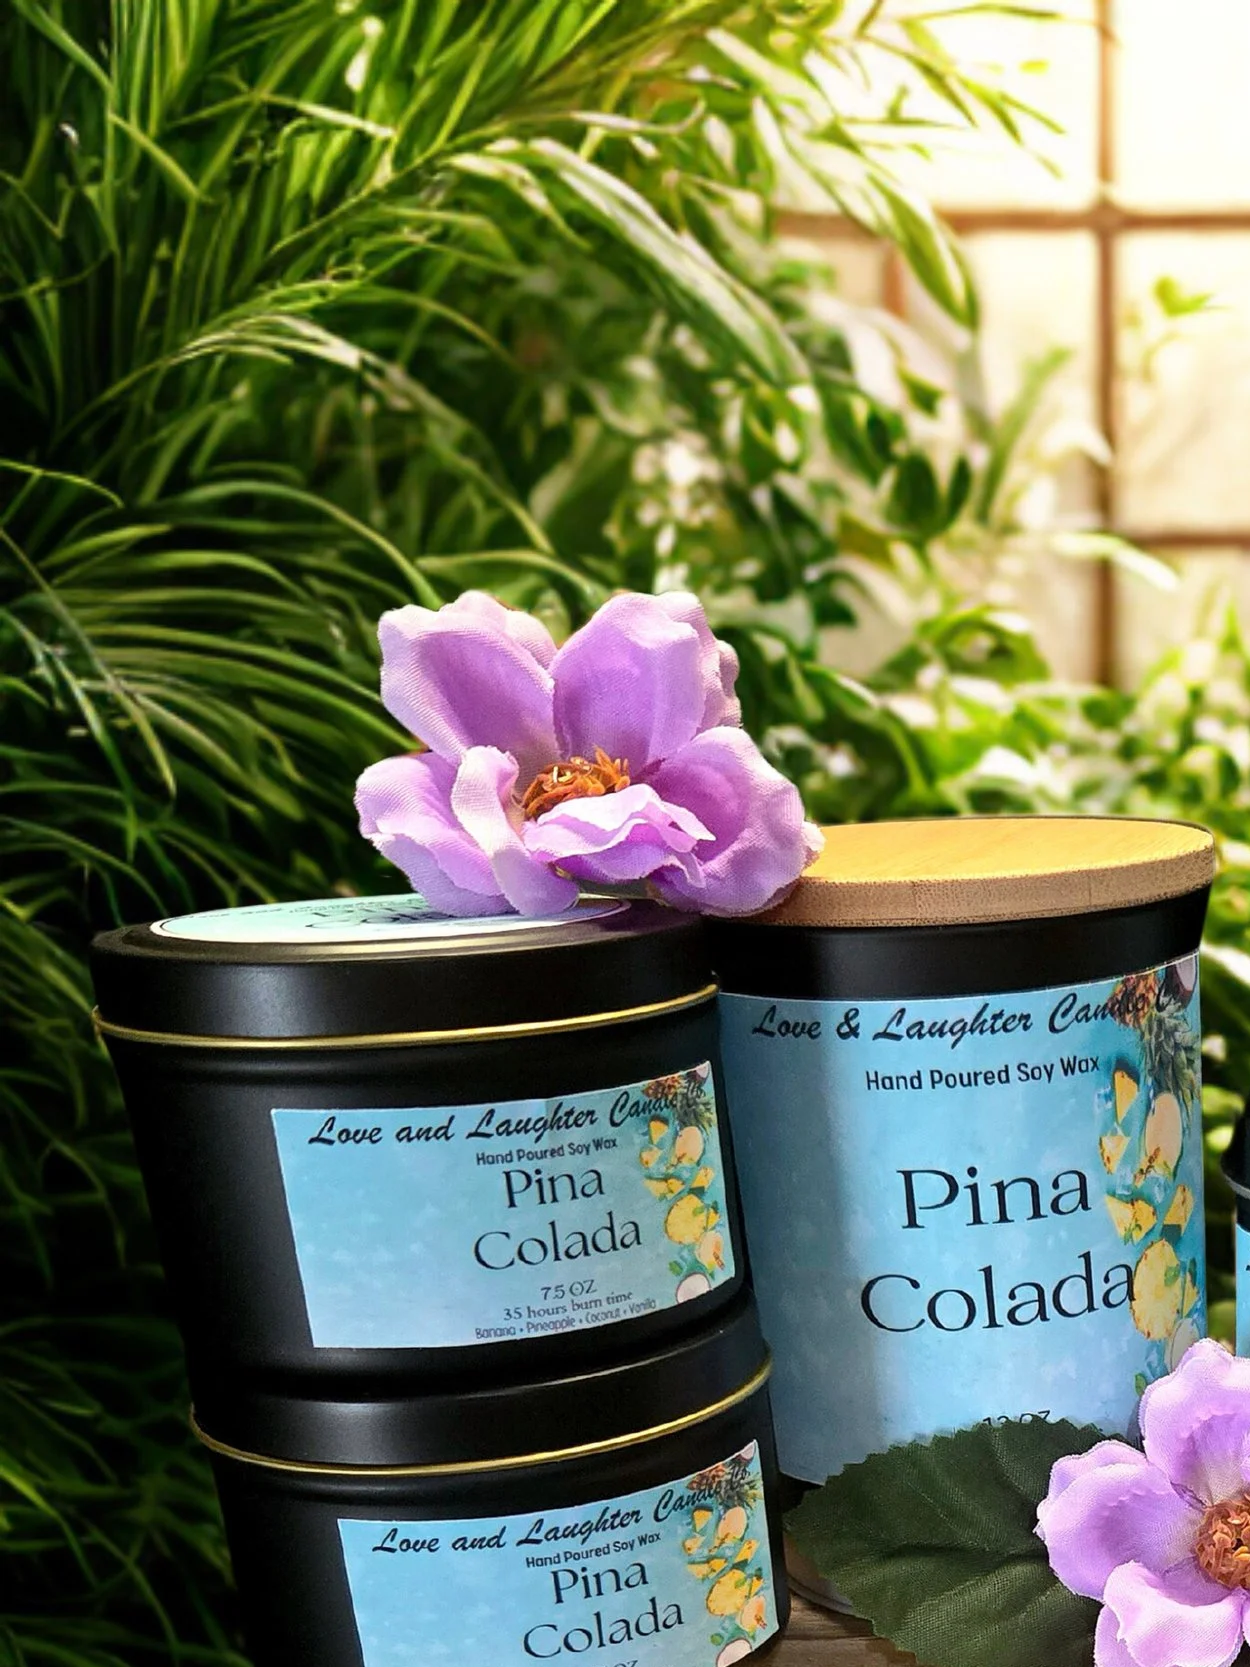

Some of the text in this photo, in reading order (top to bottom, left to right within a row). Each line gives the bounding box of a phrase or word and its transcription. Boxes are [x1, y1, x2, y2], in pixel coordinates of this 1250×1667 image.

[753, 1003, 1033, 1049] Love & Laughter
[866, 1054, 1100, 1090] Hand Poured Soy Wax
[308, 1099, 598, 1145] Love and Laughter
[476, 1137, 617, 1166] Hand Poured Soy Wax
[503, 1168, 605, 1208] Pina
[896, 1166, 1091, 1229] Pina
[474, 1211, 641, 1270] Colada
[503, 1291, 633, 1320] 35 hours burn time
[569, 1279, 597, 1296] OZ
[861, 1251, 1136, 1332] Colada
[372, 1510, 644, 1554] Love and Laughter
[526, 1532, 662, 1568] Hand Poured Soy Wax
[552, 1562, 649, 1604] Pina
[523, 1596, 684, 1659] Colada
